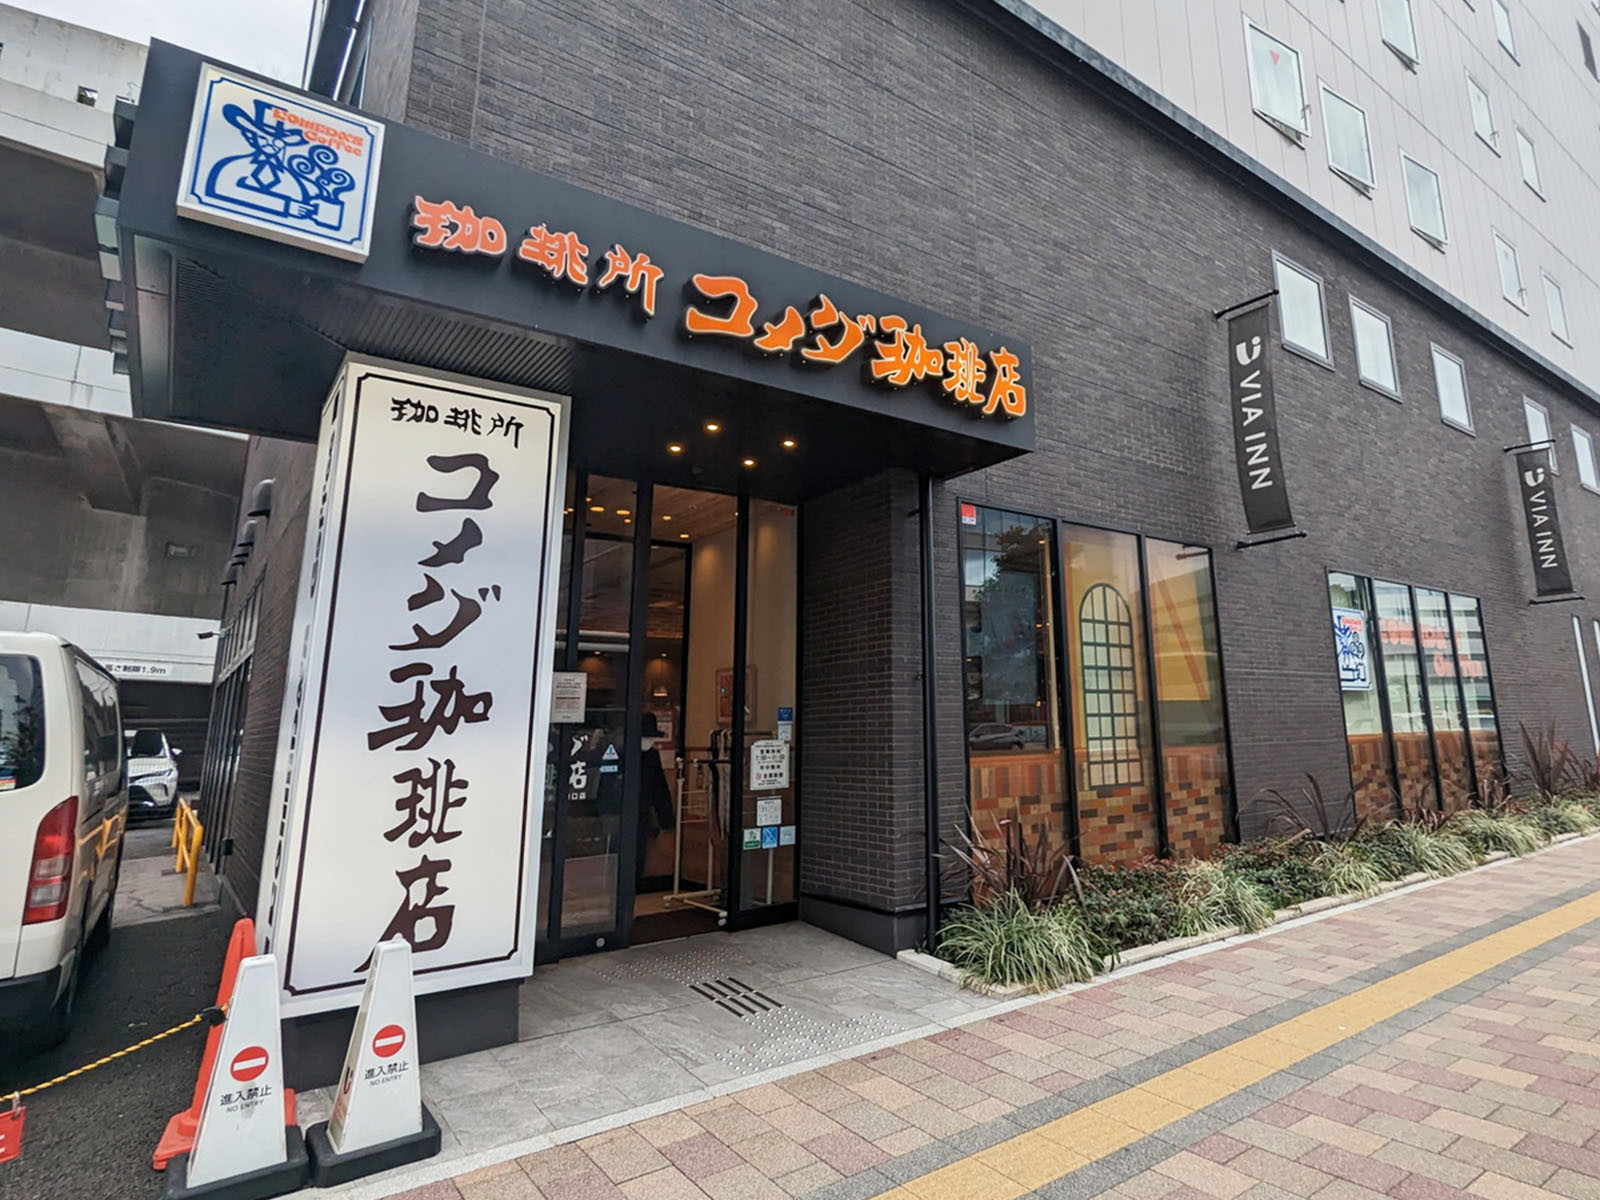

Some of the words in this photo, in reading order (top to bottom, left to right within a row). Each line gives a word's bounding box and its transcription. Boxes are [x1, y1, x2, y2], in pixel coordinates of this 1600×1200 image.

[686, 273, 1027, 417] コメダ珈琲店
[1239, 370, 1264, 426] VIA
[1244, 431, 1273, 490] INN
[1528, 490, 1549, 528] VIA
[1534, 531, 1558, 569] INN
[353, 453, 501, 974] コメダ珈琲店
[364, 1060, 409, 1080] 進入禁止
[381, 1074, 402, 1084] ENTRY
[220, 1084, 272, 1106] 進入禁止
[226, 1105, 239, 1113] NO
[240, 1099, 265, 1110] ENTRY
